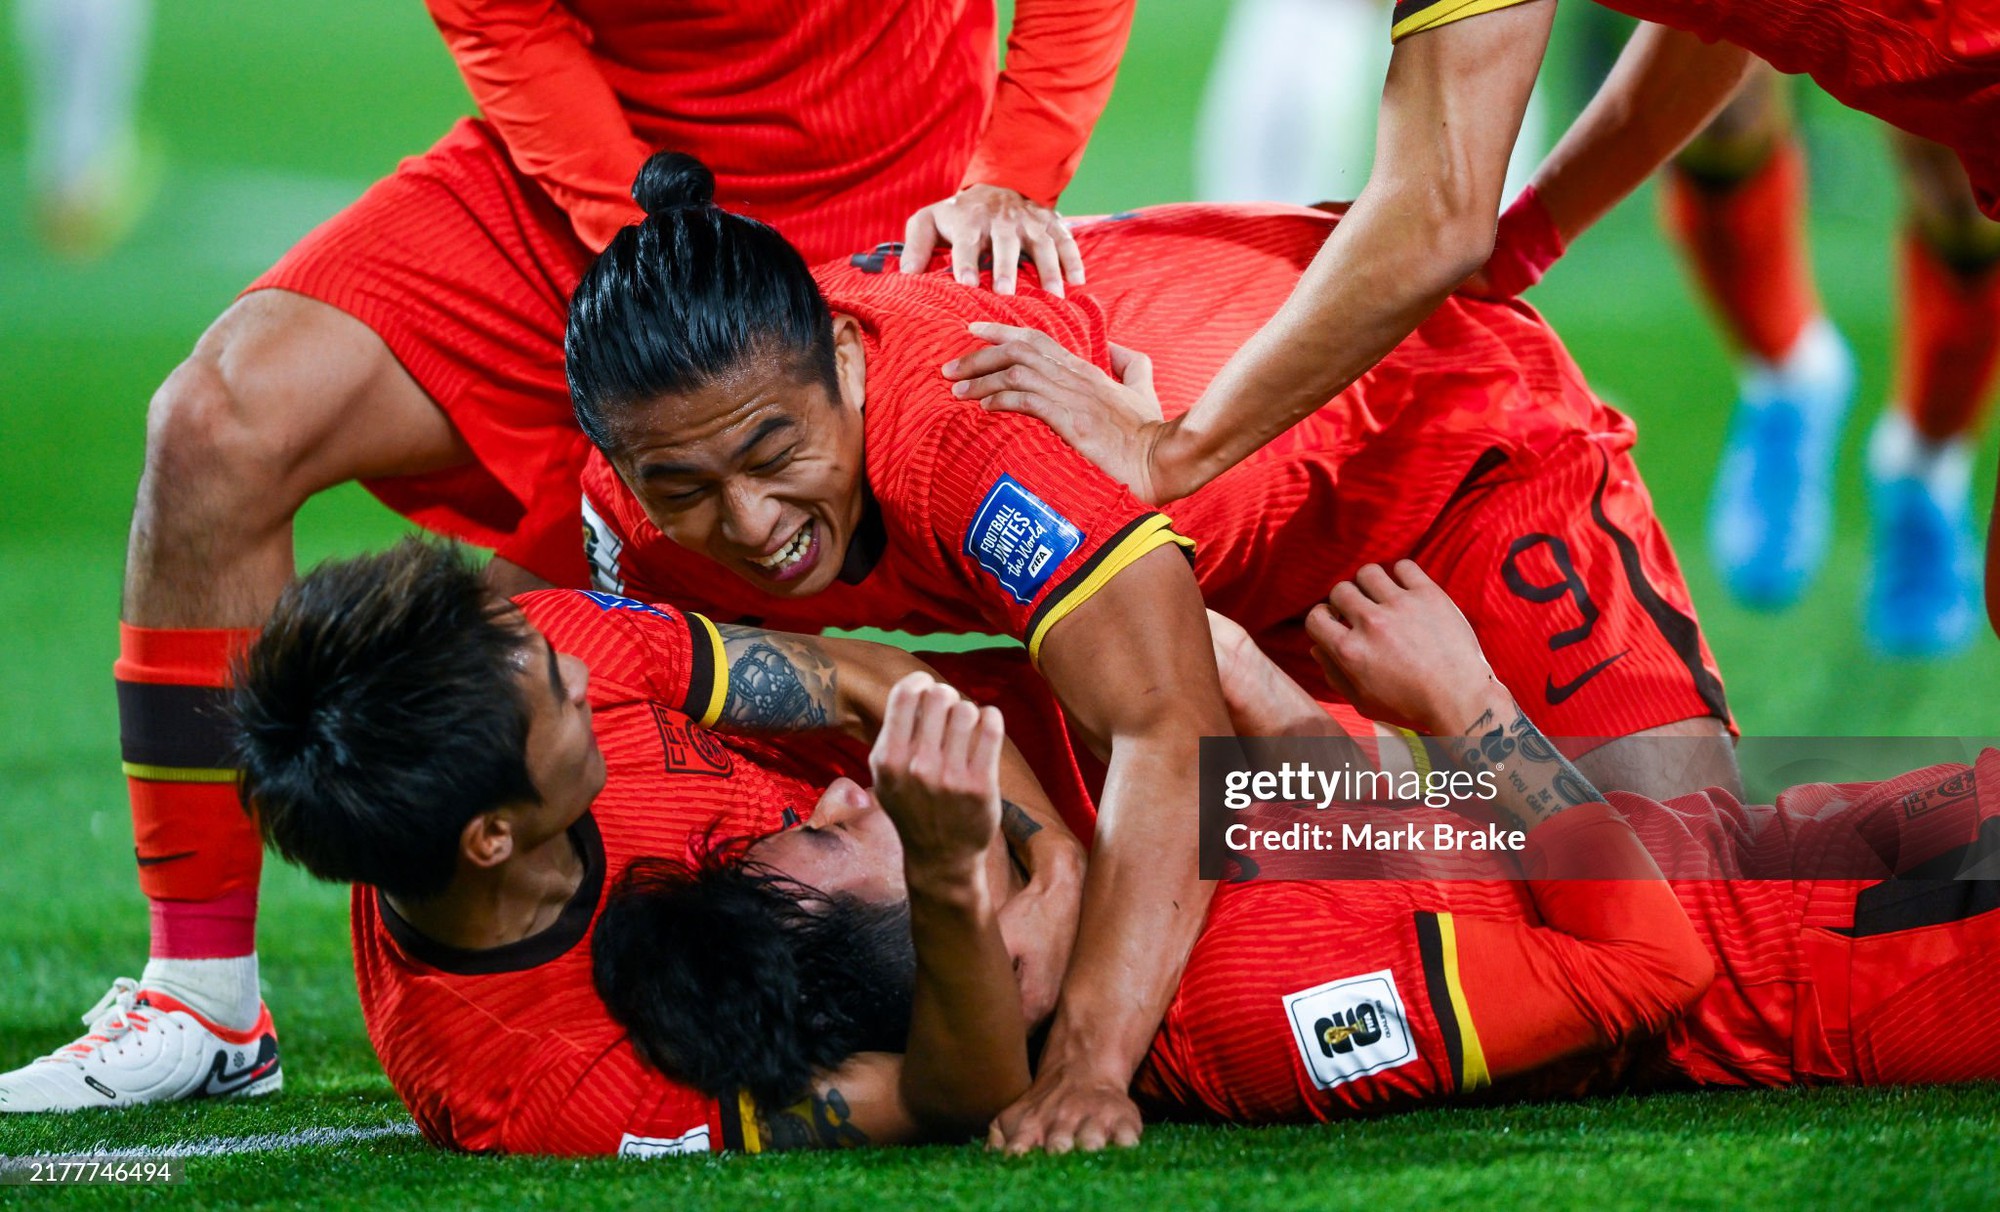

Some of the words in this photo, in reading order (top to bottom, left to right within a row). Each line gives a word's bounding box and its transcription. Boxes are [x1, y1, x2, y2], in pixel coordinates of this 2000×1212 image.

[980, 504, 1016, 554] FOOTBALL
[993, 511, 1031, 565] UNITES
[1015, 519, 1048, 559] World
[1007, 558, 1025, 577] the
[1030, 551, 1048, 572] FIFA
[1501, 532, 1600, 651] 9
[1509, 770, 1528, 793] YOU
